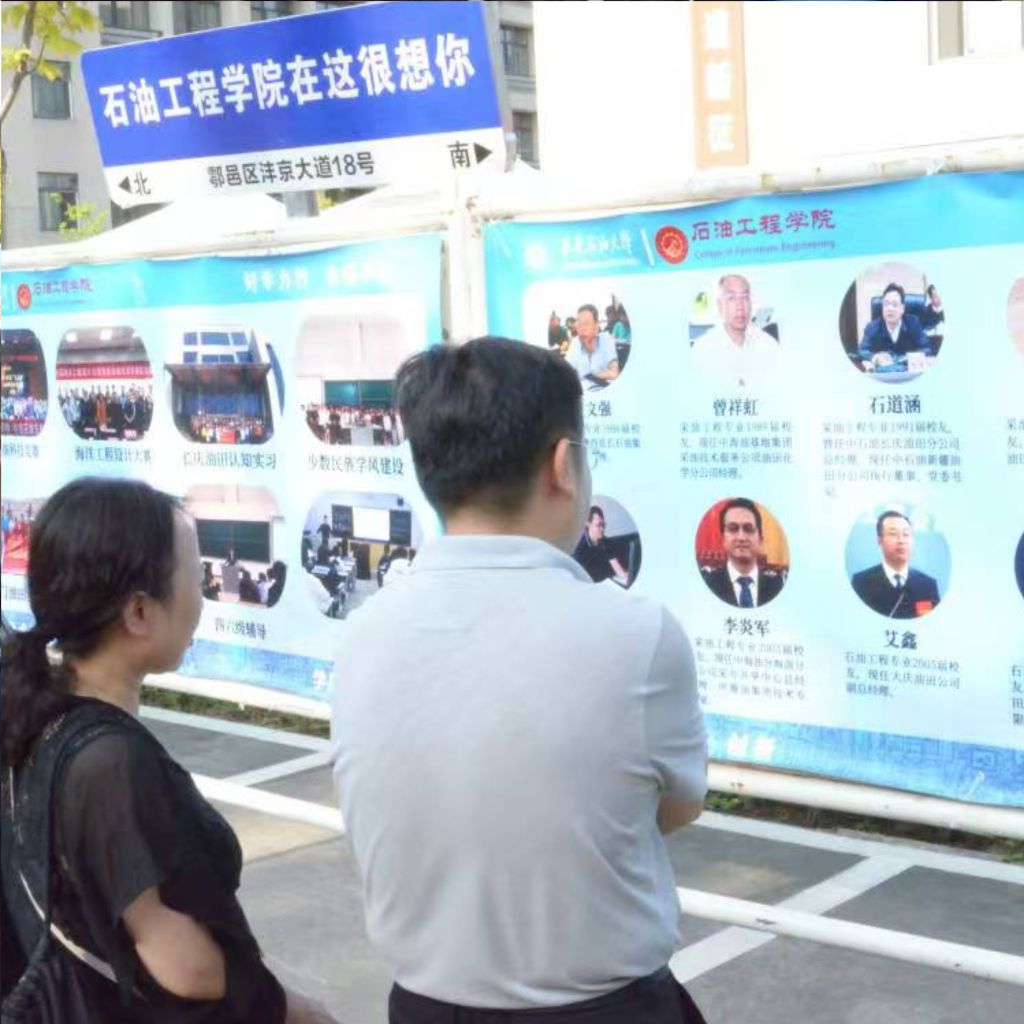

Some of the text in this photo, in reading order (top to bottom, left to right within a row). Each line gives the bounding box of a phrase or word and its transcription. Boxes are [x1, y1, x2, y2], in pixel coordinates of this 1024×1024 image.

[99, 33, 476, 129] 石油工程学院在这很想你
[447, 140, 471, 170] 南
[133, 172, 152, 196] 北
[691, 209, 836, 242] 石油工程学院
[712, 397, 759, 417] 曾祥虹
[870, 394, 922, 414] 石道涵
[723, 616, 772, 637] 李炎军
[884, 629, 918, 650] 艾鑫
